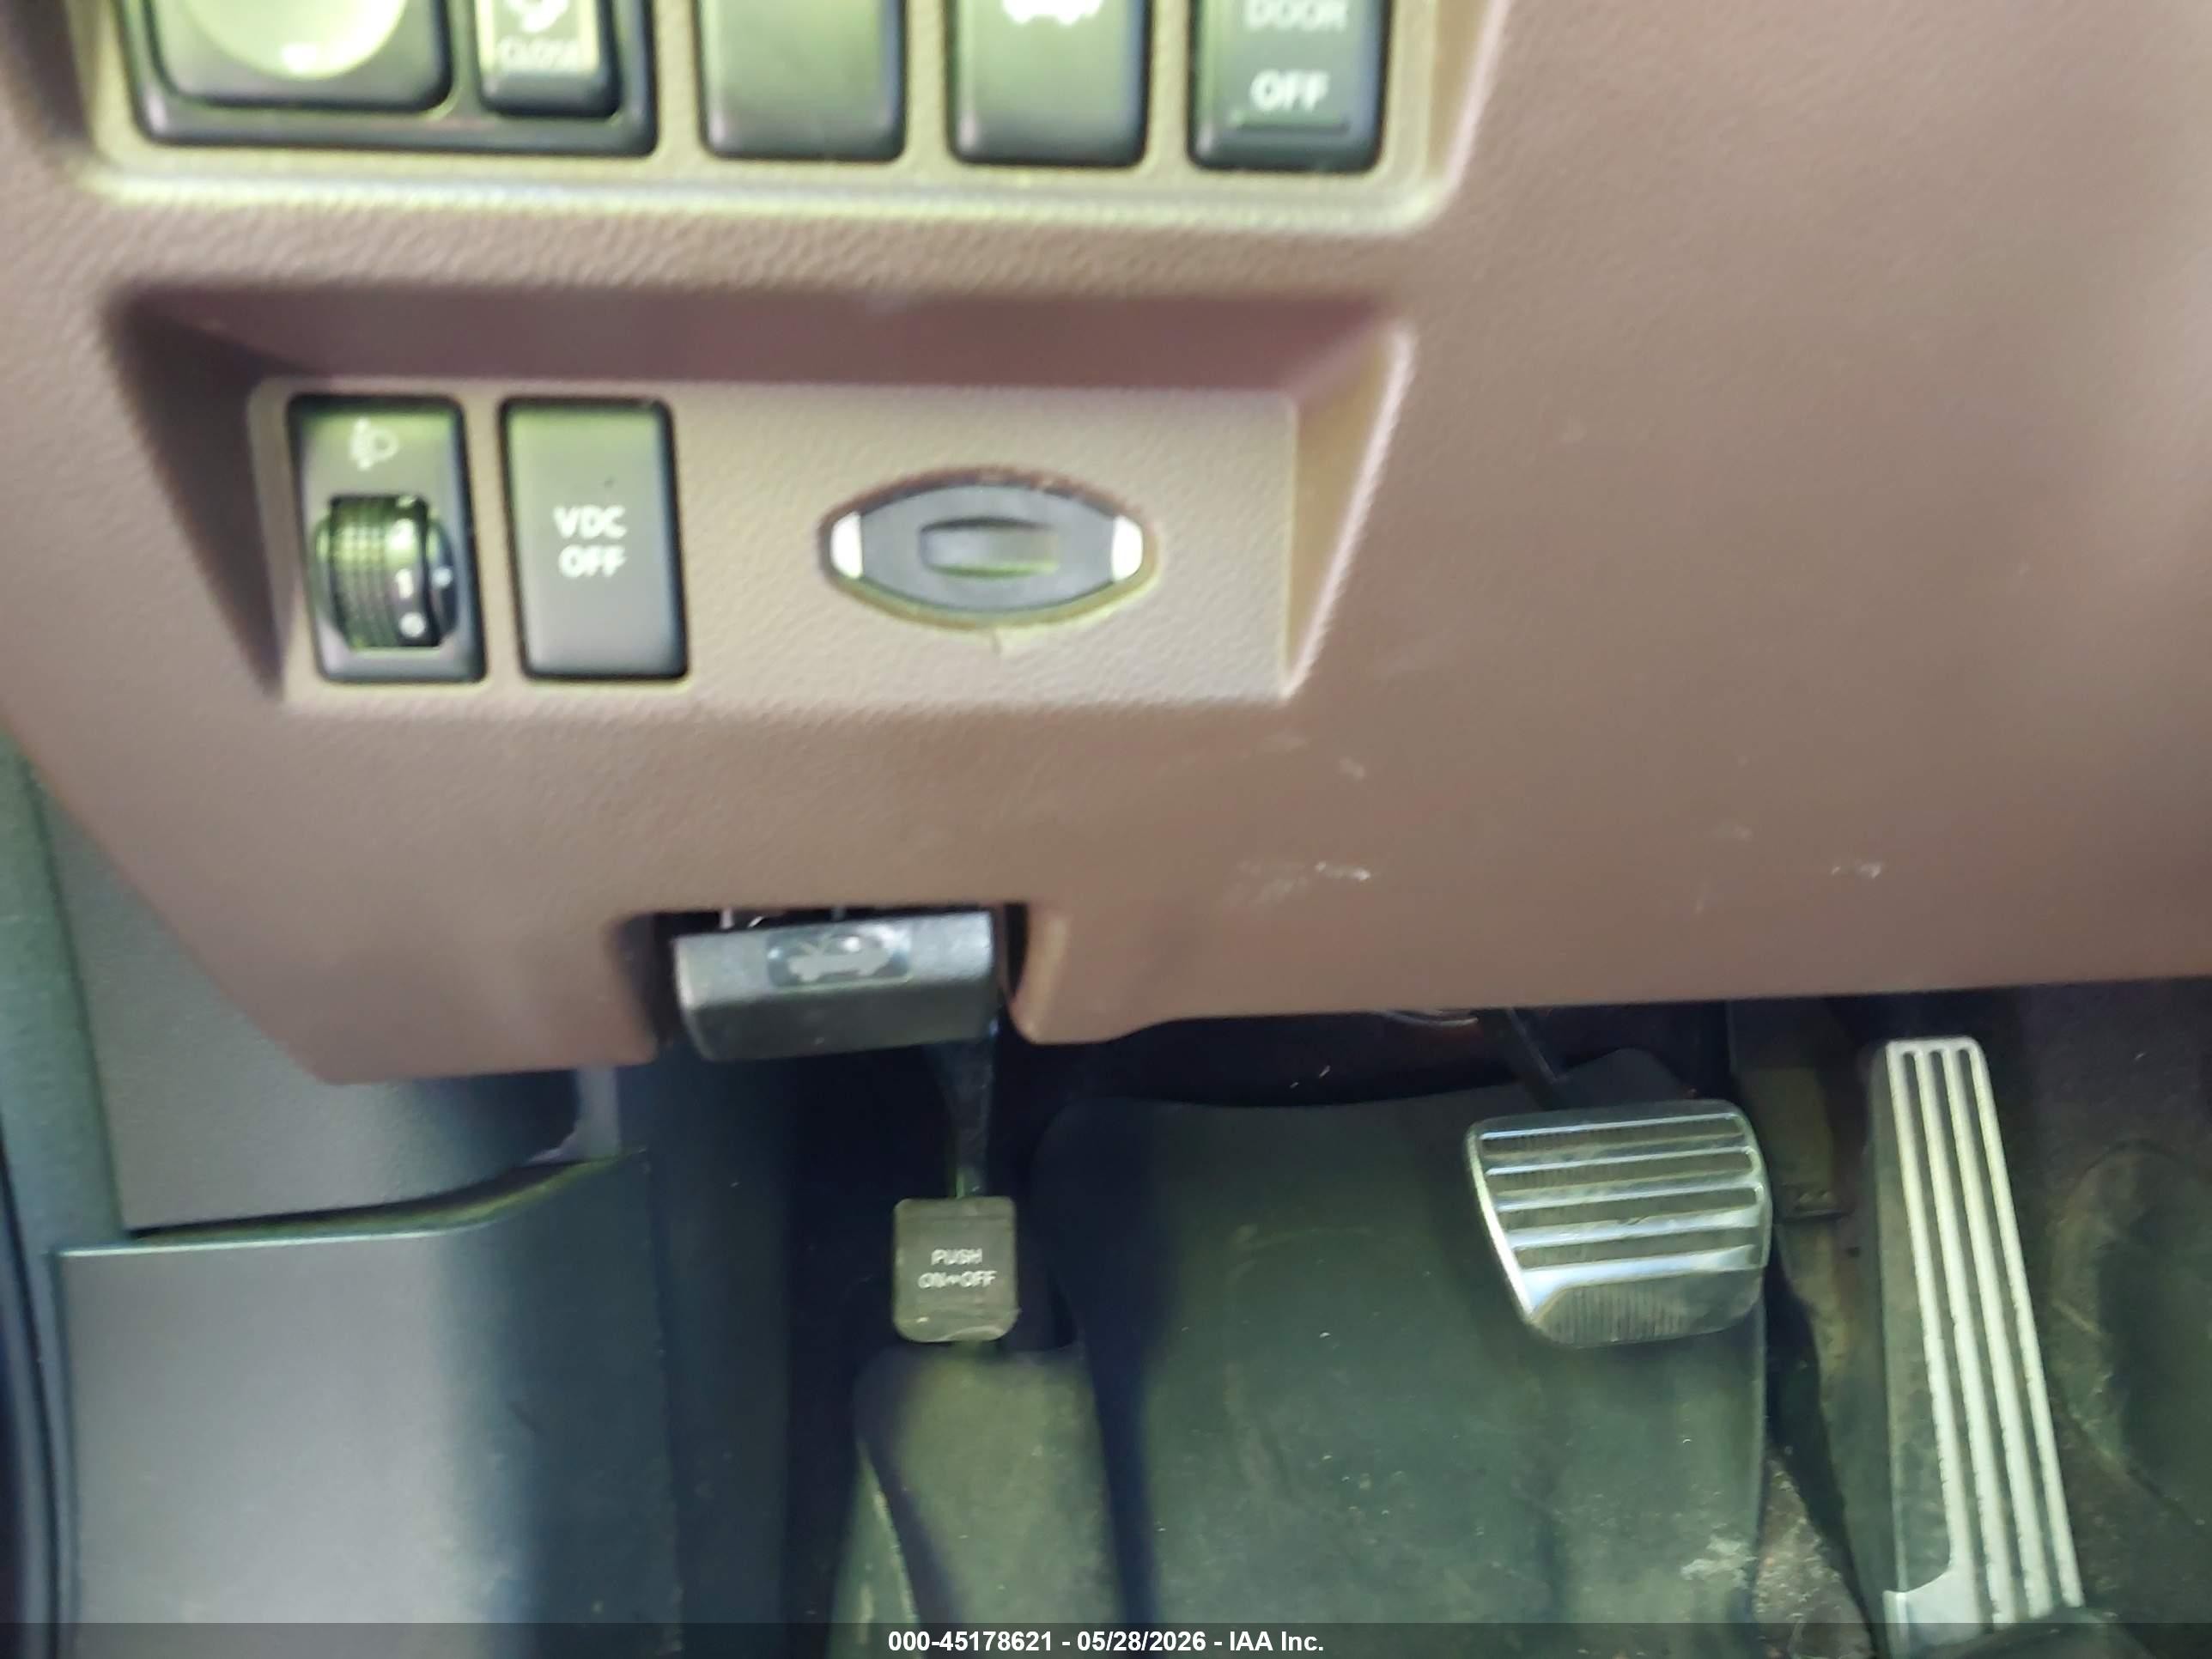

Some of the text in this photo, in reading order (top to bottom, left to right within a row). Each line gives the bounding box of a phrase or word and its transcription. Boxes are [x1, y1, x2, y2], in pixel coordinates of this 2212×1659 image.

[1245, 0, 1346, 31] DOOR
[1249, 69, 1330, 112] OFF
[552, 504, 628, 539] VDC
[557, 544, 628, 578] OFF
[931, 1248, 983, 1266] PUSH
